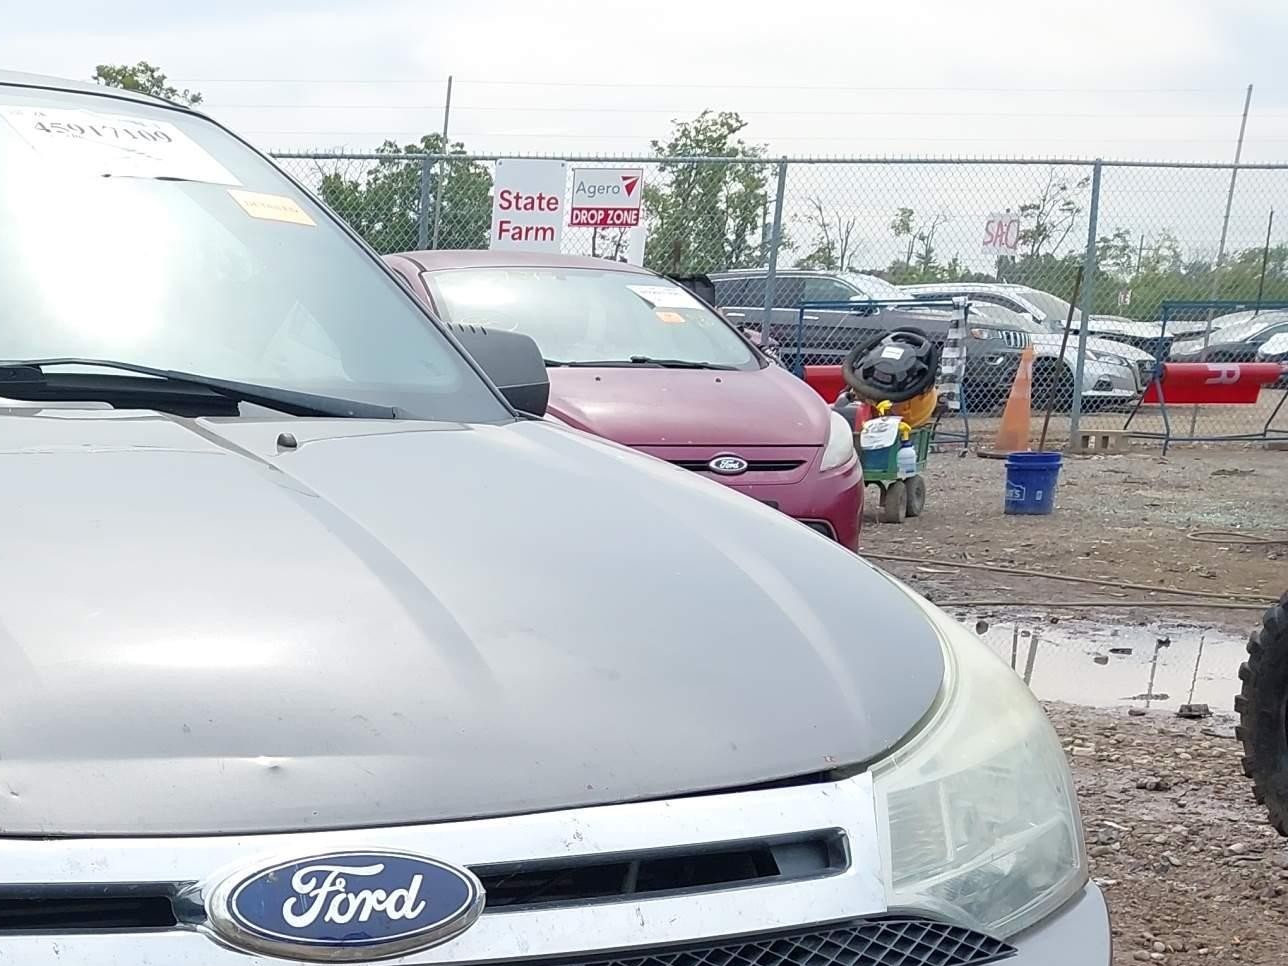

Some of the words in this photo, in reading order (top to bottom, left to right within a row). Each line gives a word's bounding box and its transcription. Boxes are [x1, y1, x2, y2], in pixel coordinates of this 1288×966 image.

[498, 189, 559, 211] State
[575, 181, 621, 198] Agero
[572, 209, 604, 225] DROP
[606, 209, 638, 225] ZONE
[498, 220, 555, 241] Farm
[282, 863, 427, 928] Ford
